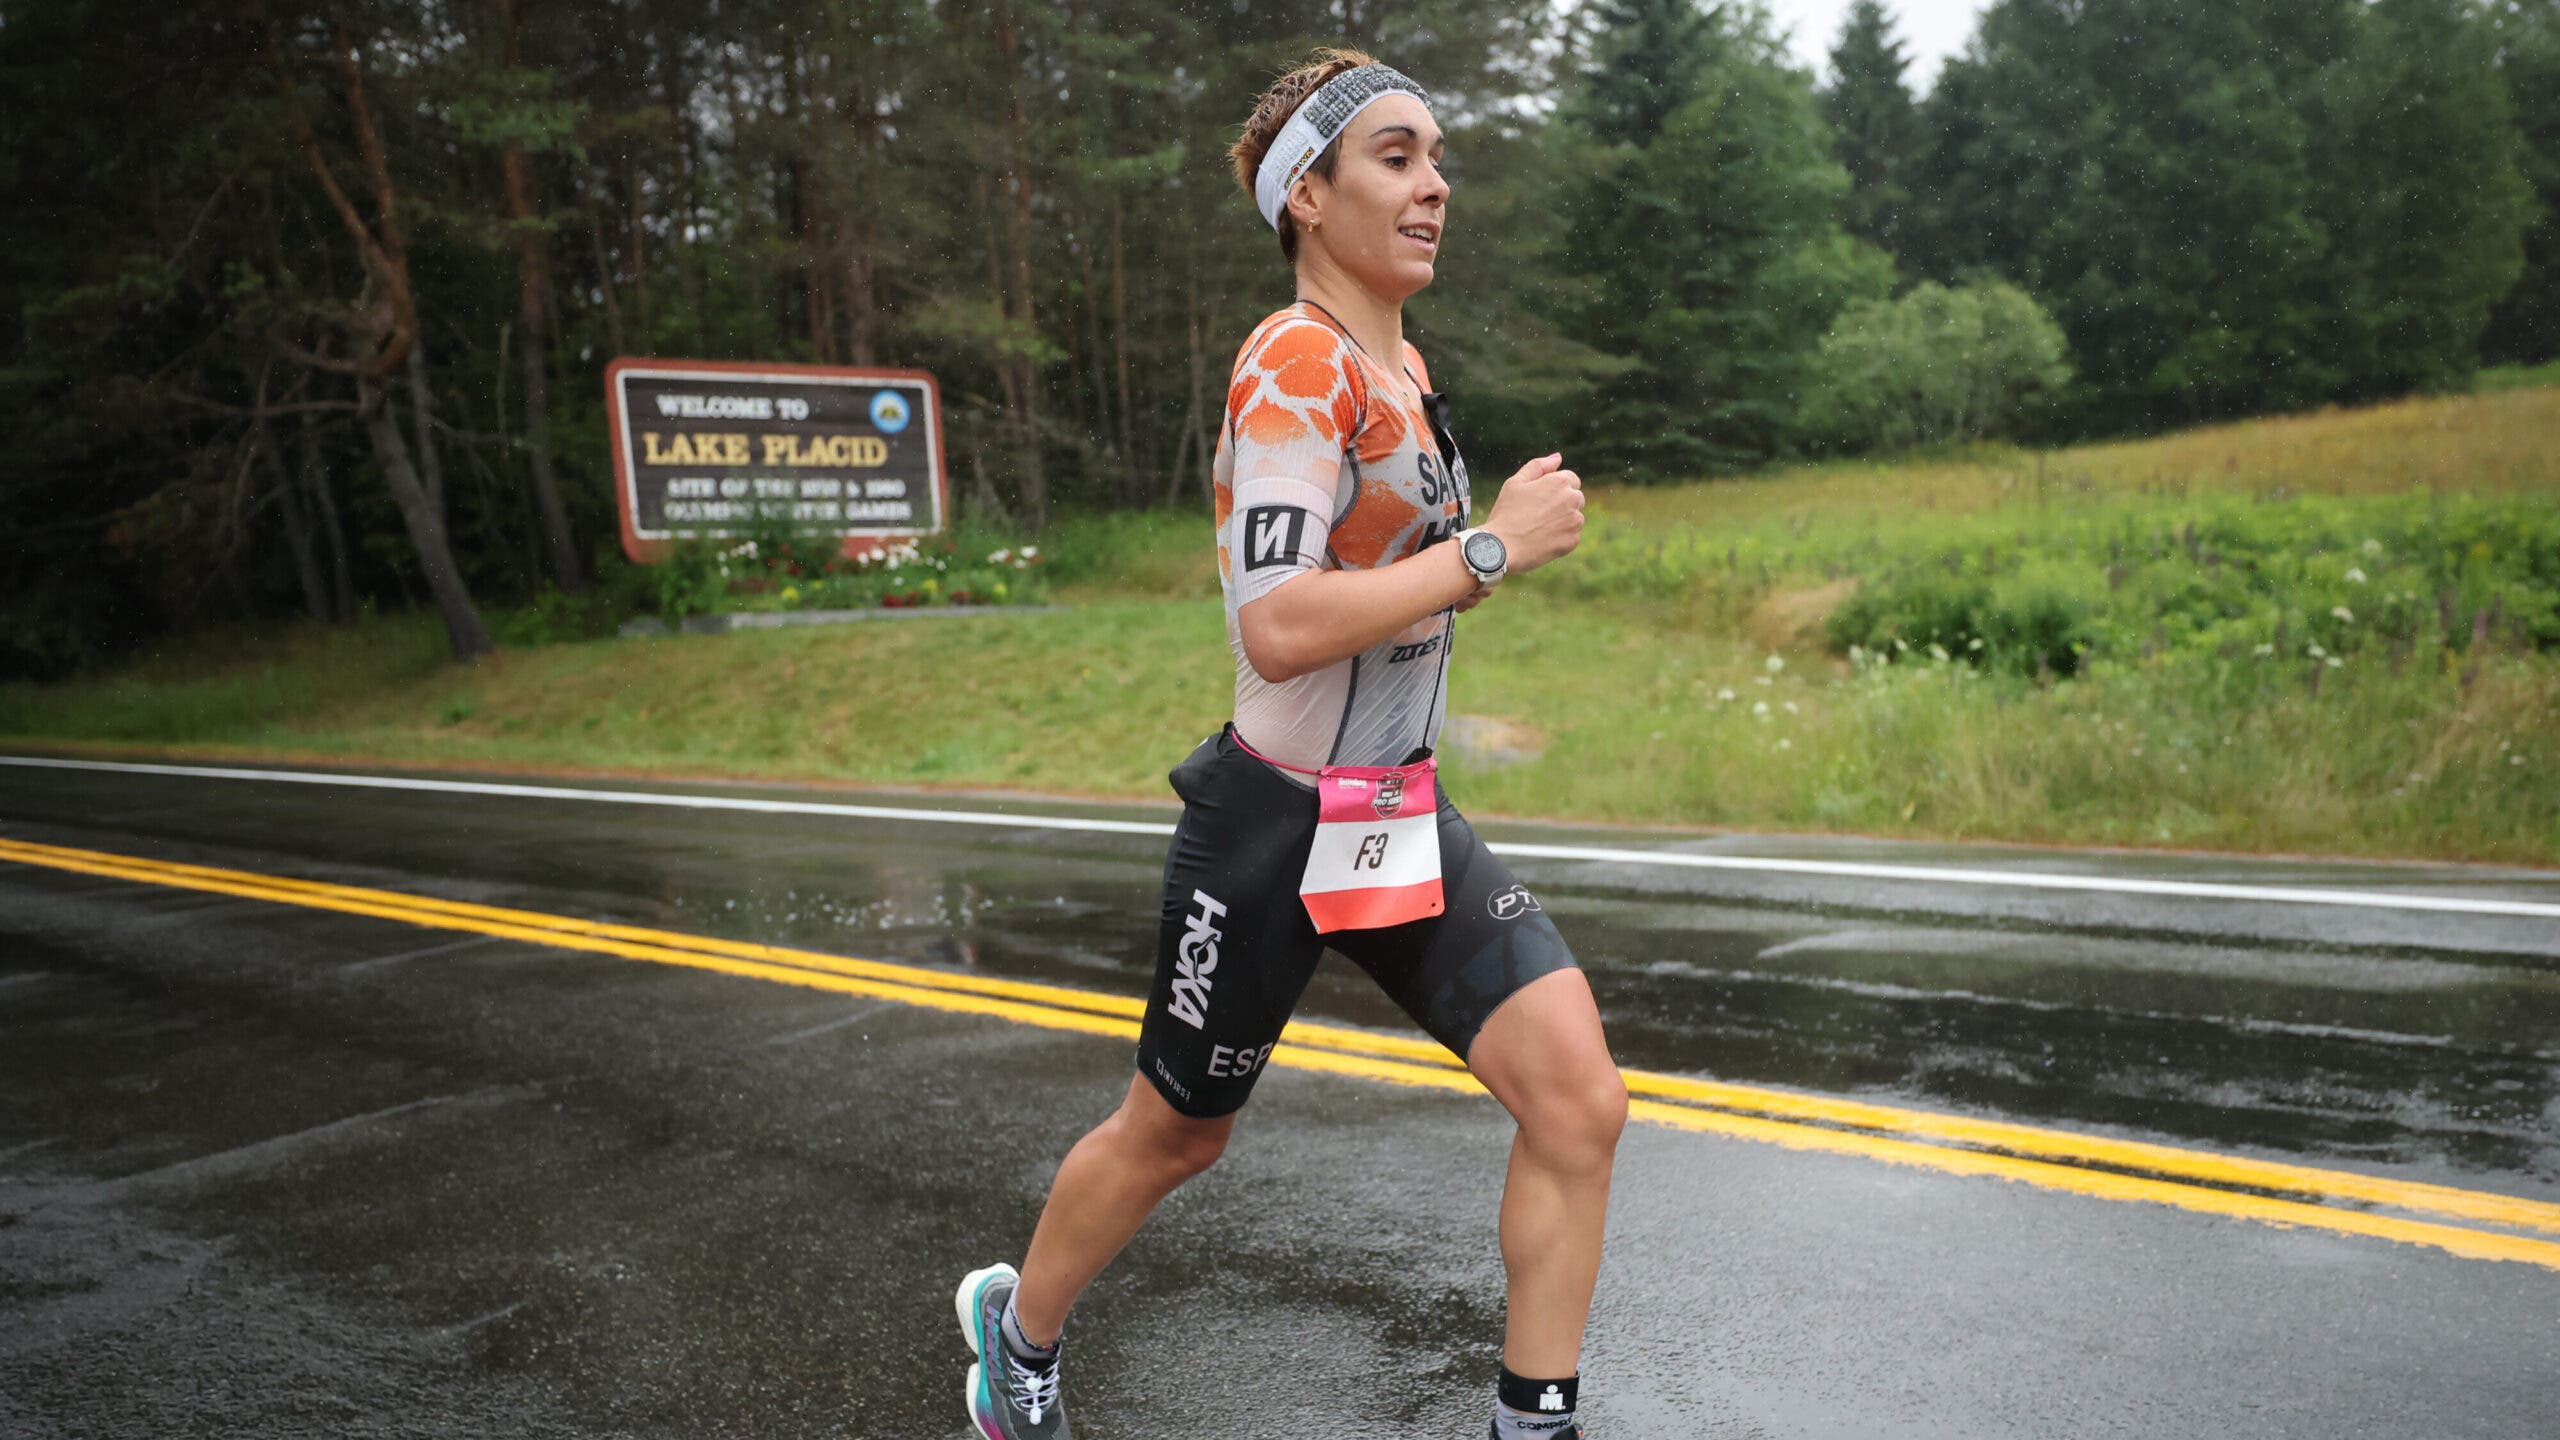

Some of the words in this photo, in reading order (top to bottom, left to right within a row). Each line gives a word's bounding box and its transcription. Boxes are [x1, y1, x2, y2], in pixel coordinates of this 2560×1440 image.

[657, 394, 773, 420] WELCOME
[776, 397, 810, 421] TO
[643, 432, 750, 465] LAKE
[762, 434, 888, 467] PLACID
[1354, 833, 1389, 870] F3
[1168, 889, 1228, 1030] HOKA
